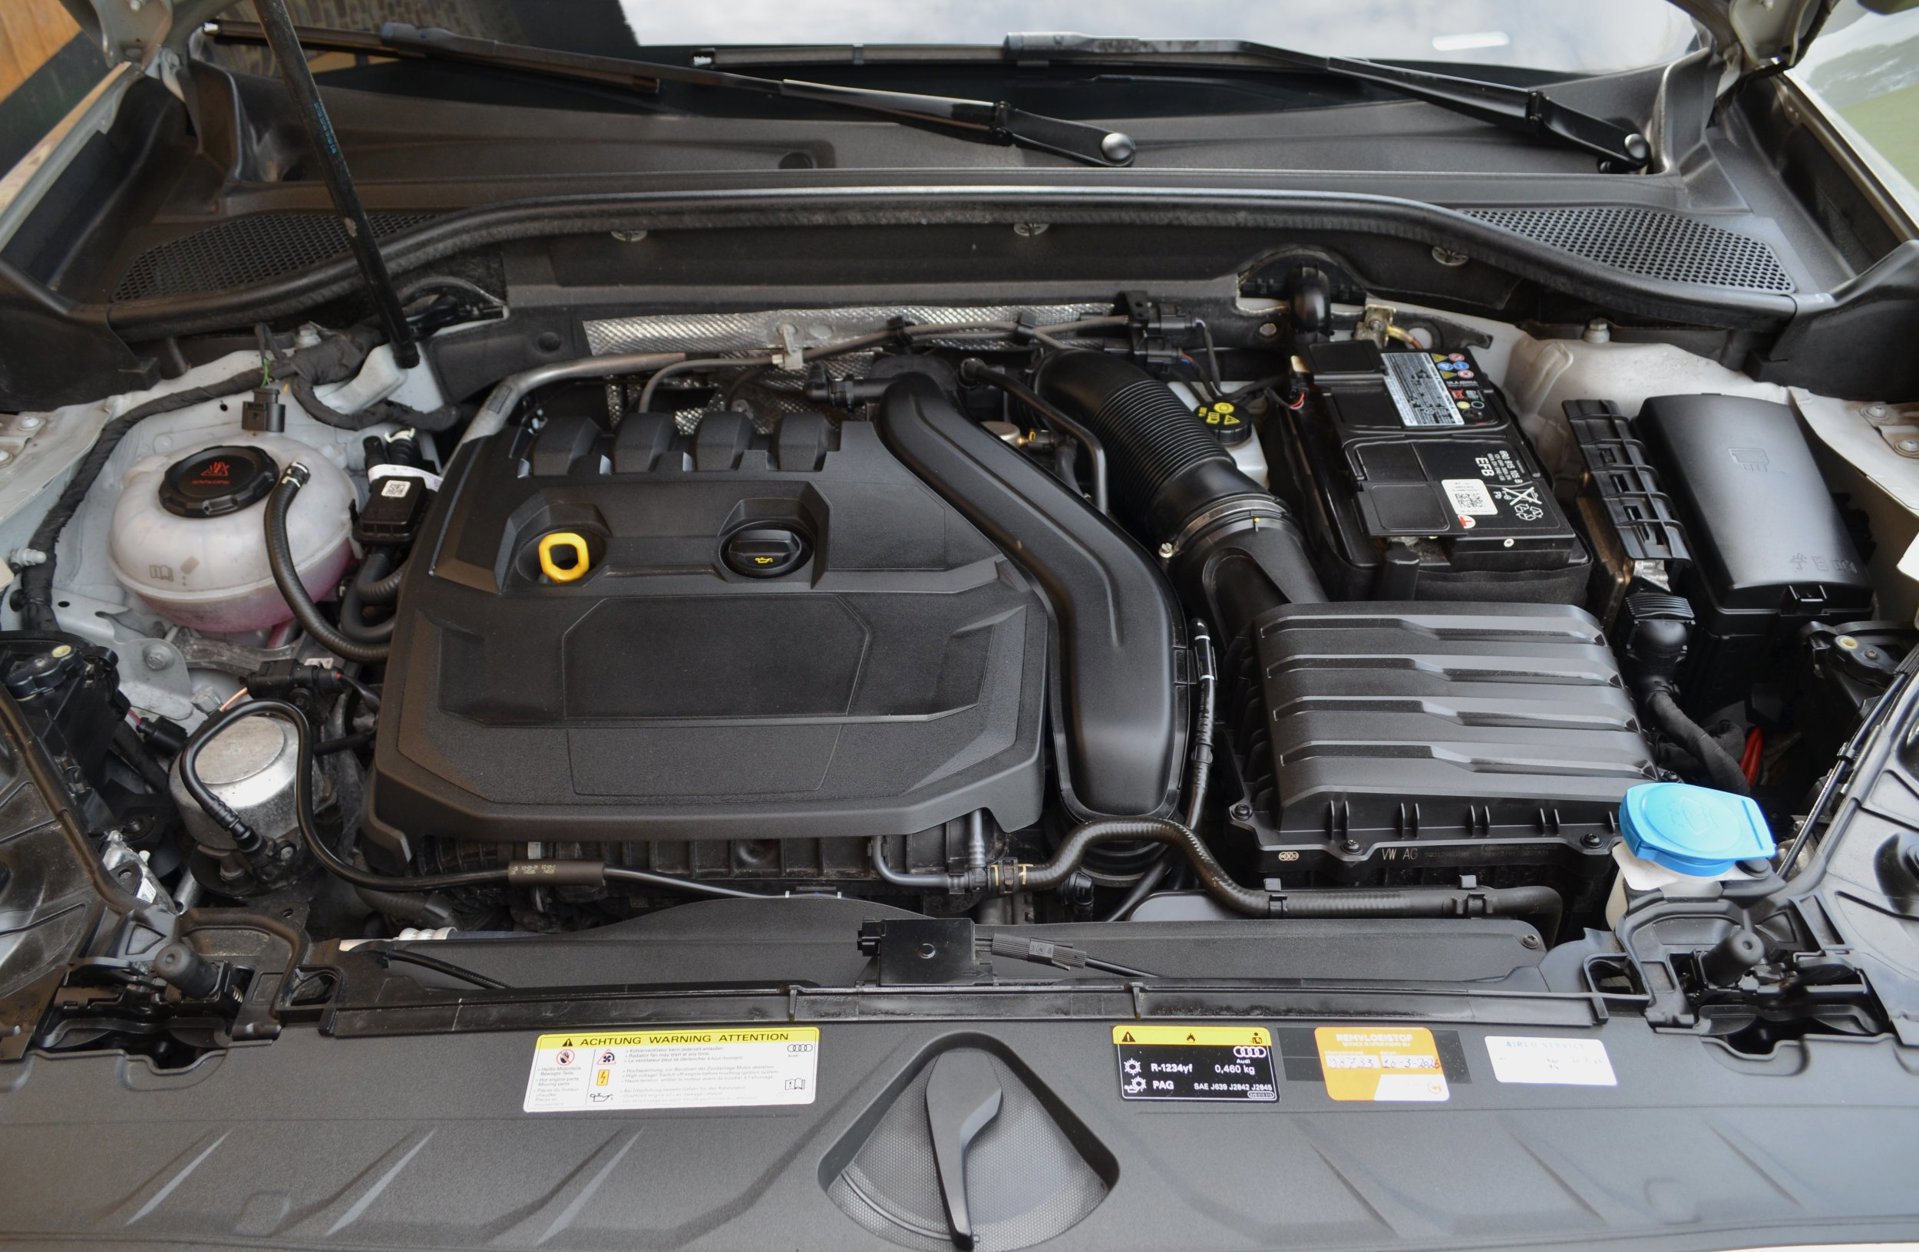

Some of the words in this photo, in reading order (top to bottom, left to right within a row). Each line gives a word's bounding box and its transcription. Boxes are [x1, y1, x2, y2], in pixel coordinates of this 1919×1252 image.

[1475, 457, 1495, 477] EFB
[1382, 848, 1397, 860] VW
[1402, 848, 1418, 860] AG
[579, 1037, 642, 1046] ACHTUNG
[648, 1035, 712, 1044] WARNING
[718, 1033, 789, 1042] ATTENTION
[1150, 1063, 1193, 1074] R-1234yf
[1243, 1064, 1256, 1075] kg
[1152, 1080, 1174, 1090] PAG
